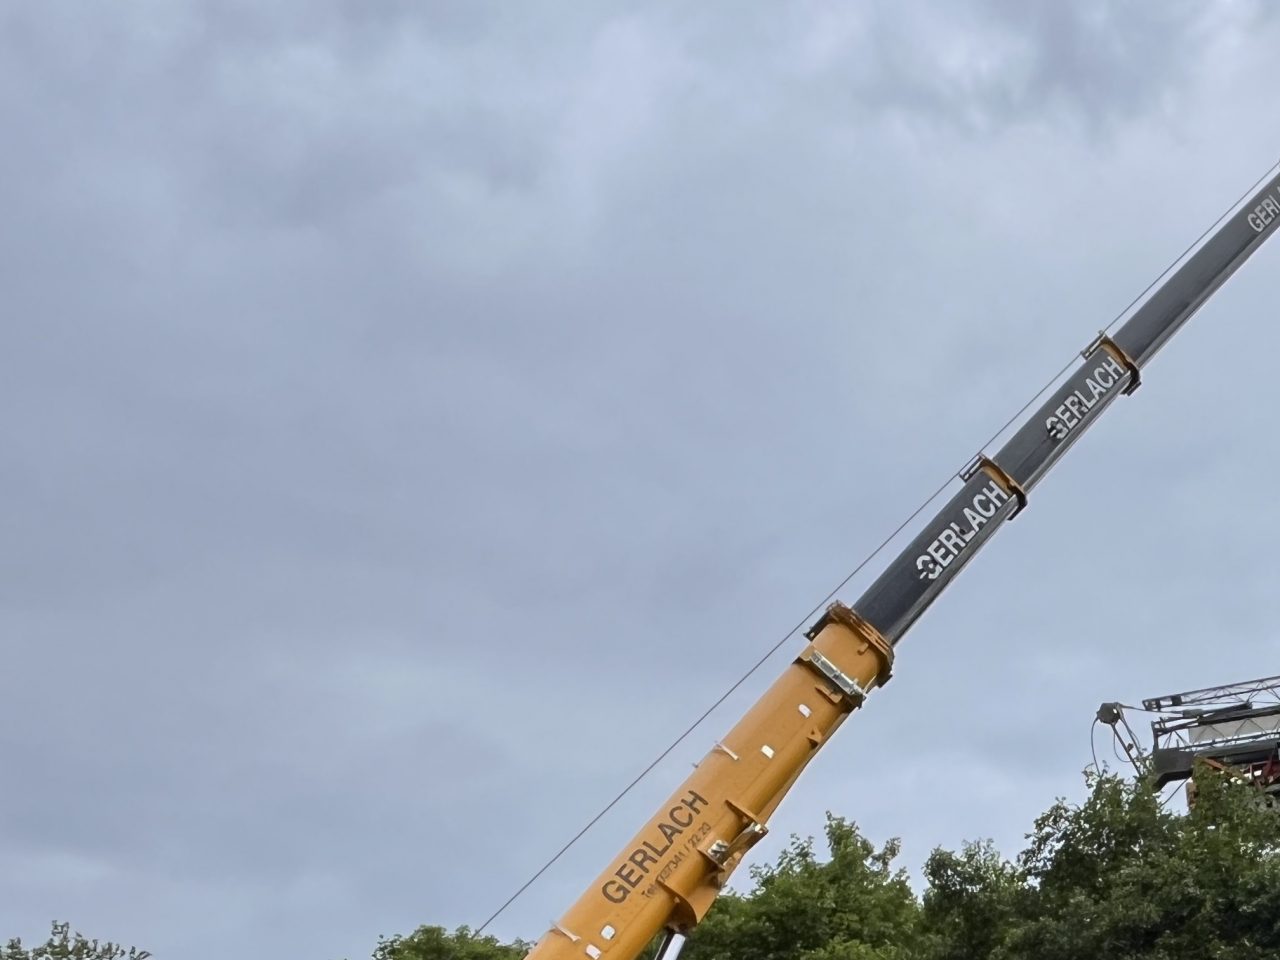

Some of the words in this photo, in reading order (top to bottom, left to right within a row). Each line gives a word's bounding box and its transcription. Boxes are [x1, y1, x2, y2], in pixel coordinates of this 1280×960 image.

[1046, 356, 1124, 439] GERLACH
[916, 480, 1008, 579] GERLACH
[601, 790, 709, 904] GERLACH
